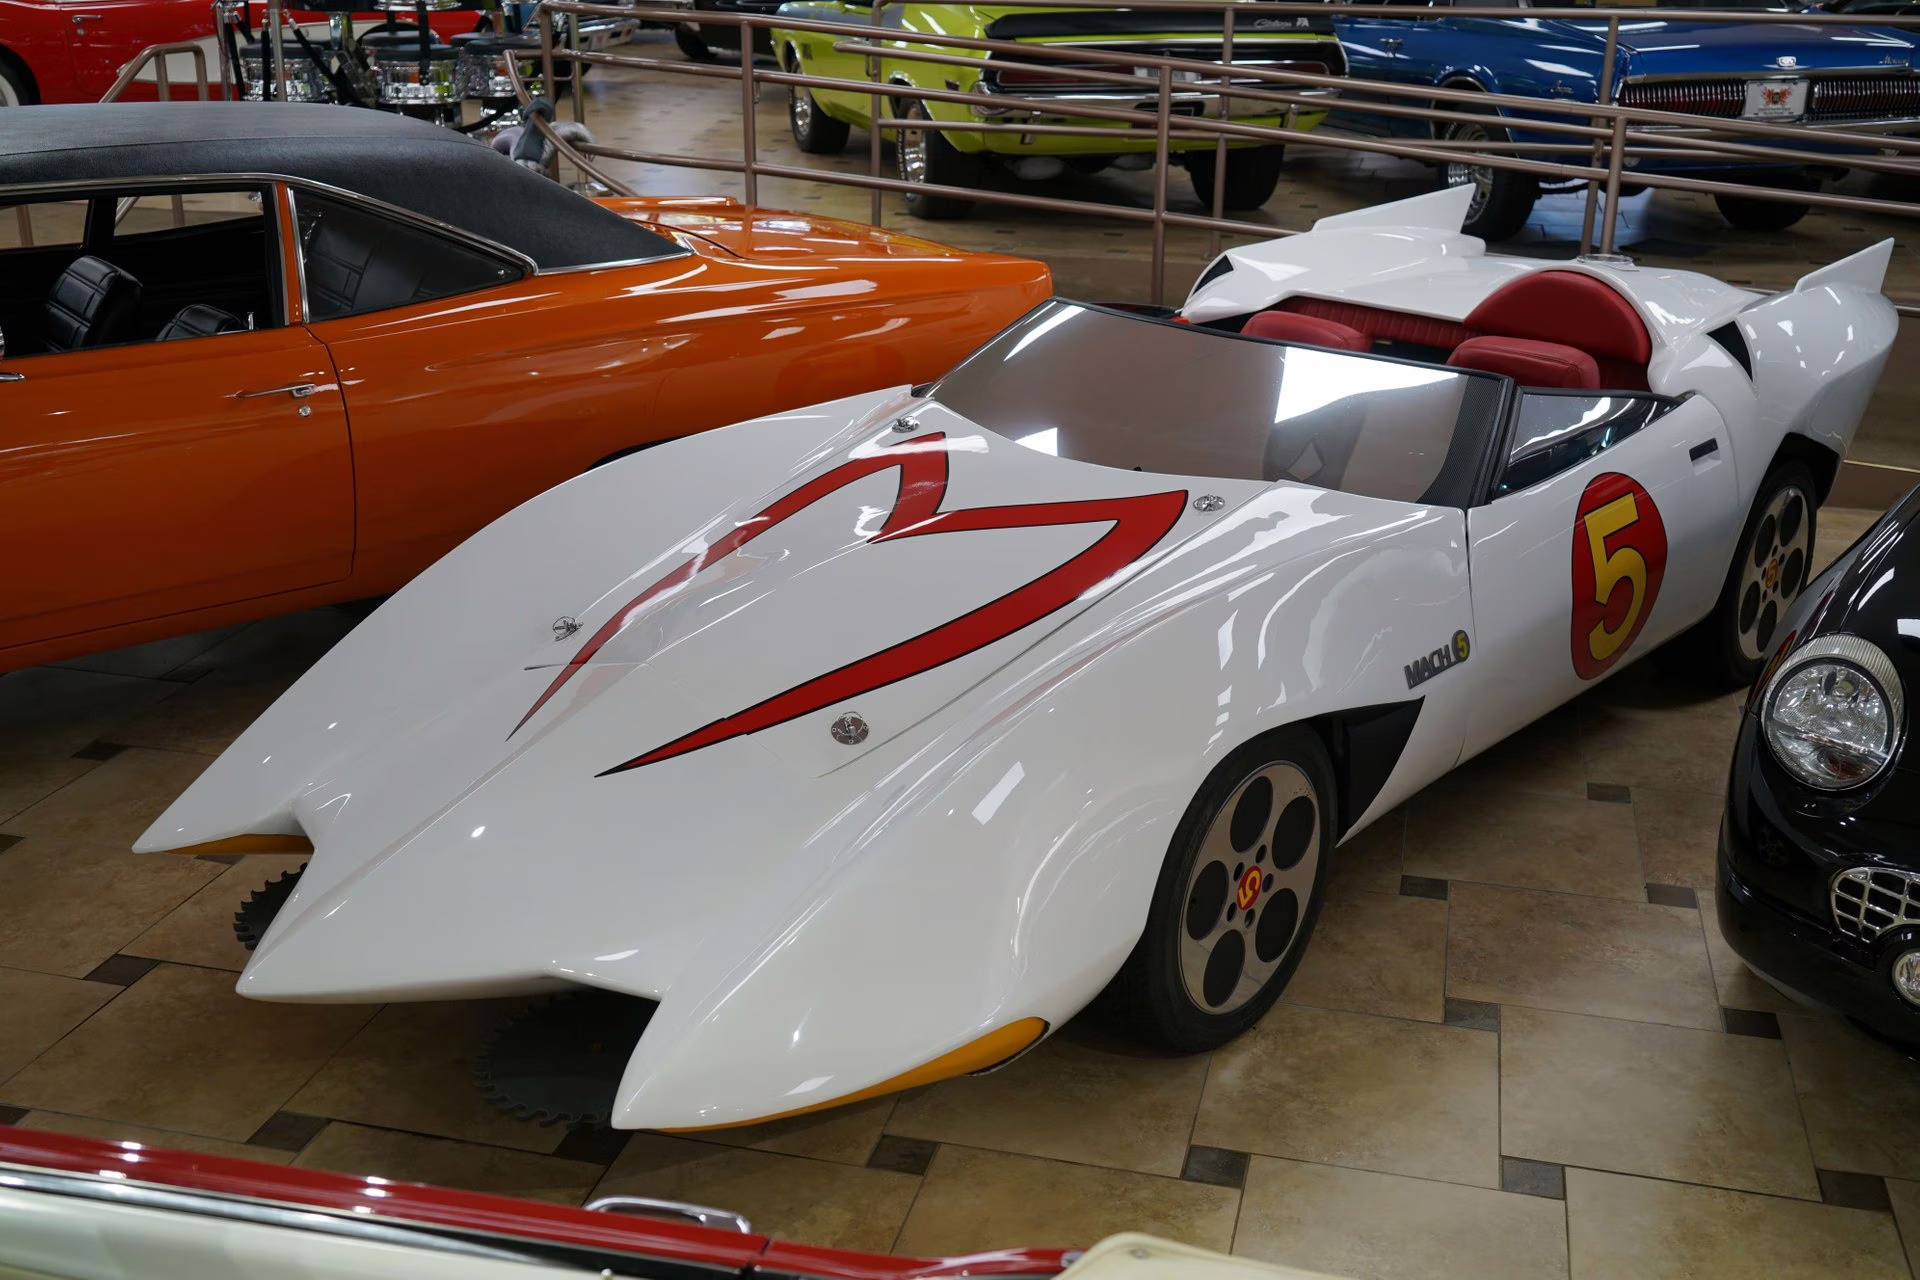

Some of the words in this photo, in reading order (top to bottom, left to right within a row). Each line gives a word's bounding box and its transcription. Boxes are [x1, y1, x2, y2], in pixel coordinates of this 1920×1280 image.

[1583, 492, 1647, 661] 5
[1404, 644, 1452, 690] MACH
[1455, 631, 1469, 660] 5
[1238, 870, 1261, 909] 5
